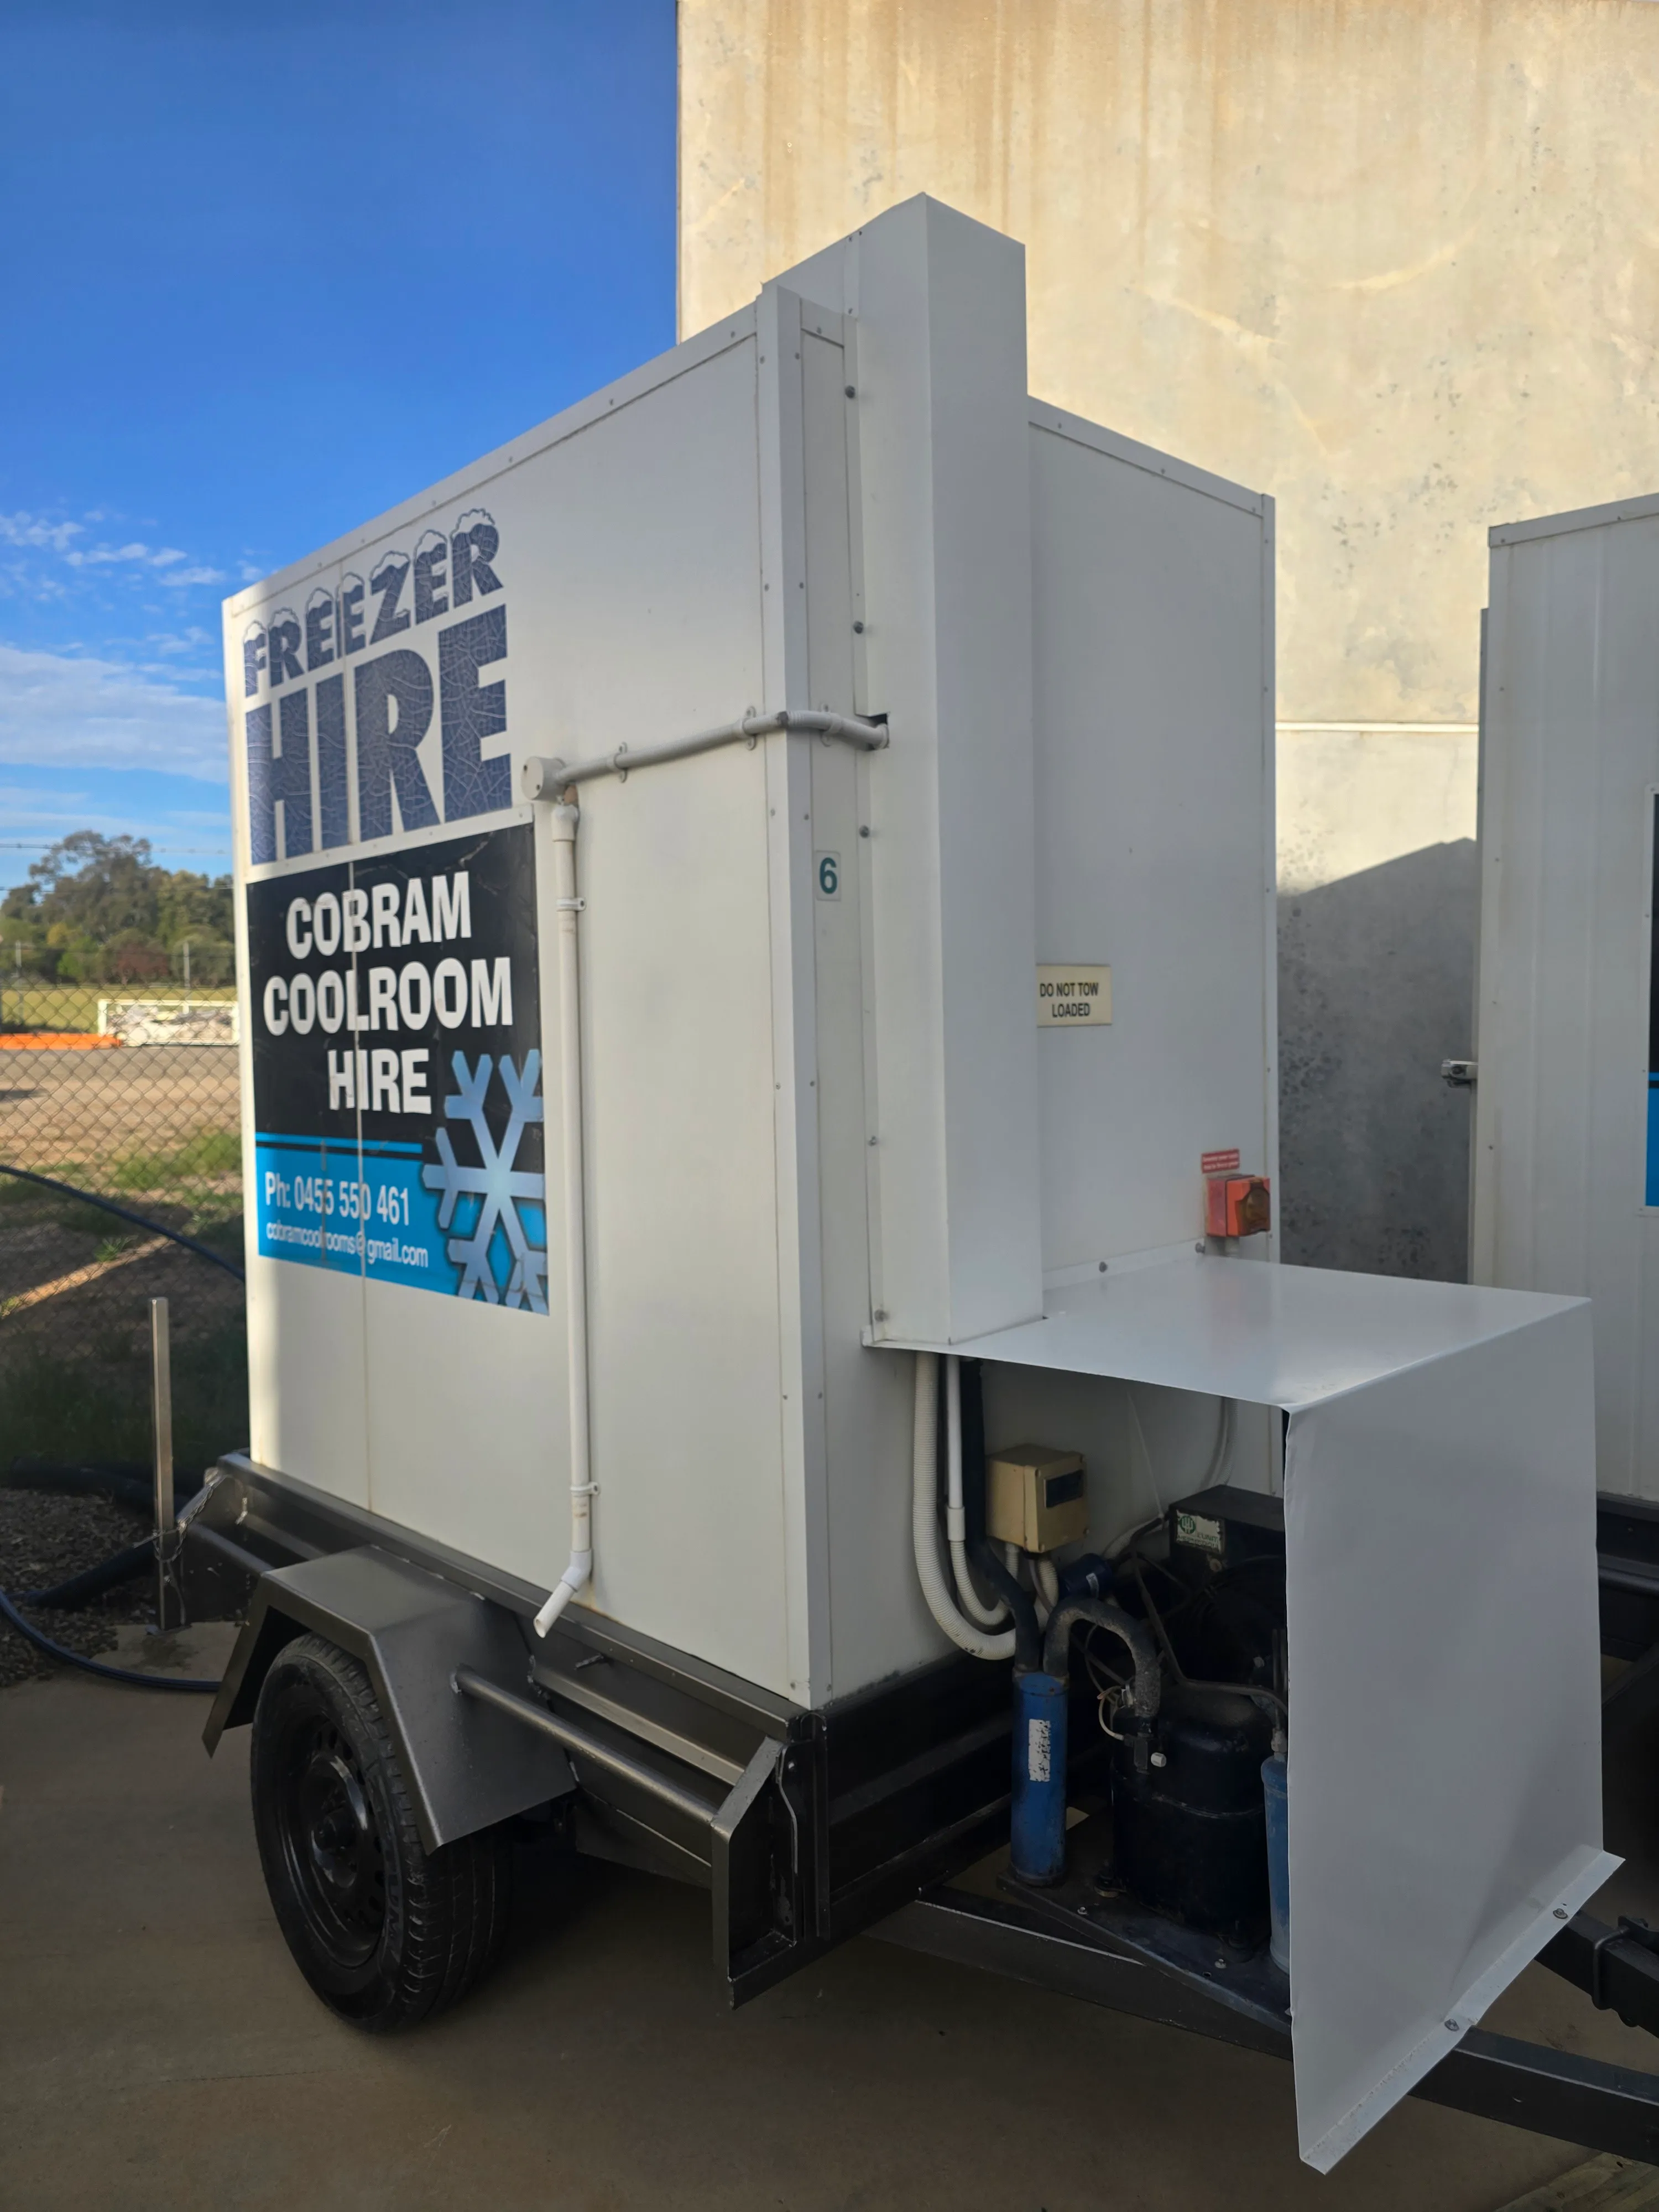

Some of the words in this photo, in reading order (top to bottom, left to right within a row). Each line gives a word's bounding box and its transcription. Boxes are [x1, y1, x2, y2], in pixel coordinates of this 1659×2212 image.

[243, 509, 504, 698] FREEZER
[245, 603, 513, 866] HIRE
[819, 857, 837, 895] 6
[286, 870, 472, 959] COBRAM
[263, 957, 513, 1036] COOLROOM
[1040, 983, 1054, 998] DO
[1056, 983, 1075, 997] NOT
[1077, 982, 1099, 997] TOW
[1052, 1003, 1091, 1018] LOADED
[327, 1048, 432, 1114] HIRE
[265, 1171, 291, 1208] Ph:
[294, 1176, 335, 1215] 0455
[339, 1181, 372, 1221] 550
[376, 1185, 410, 1227] 461
